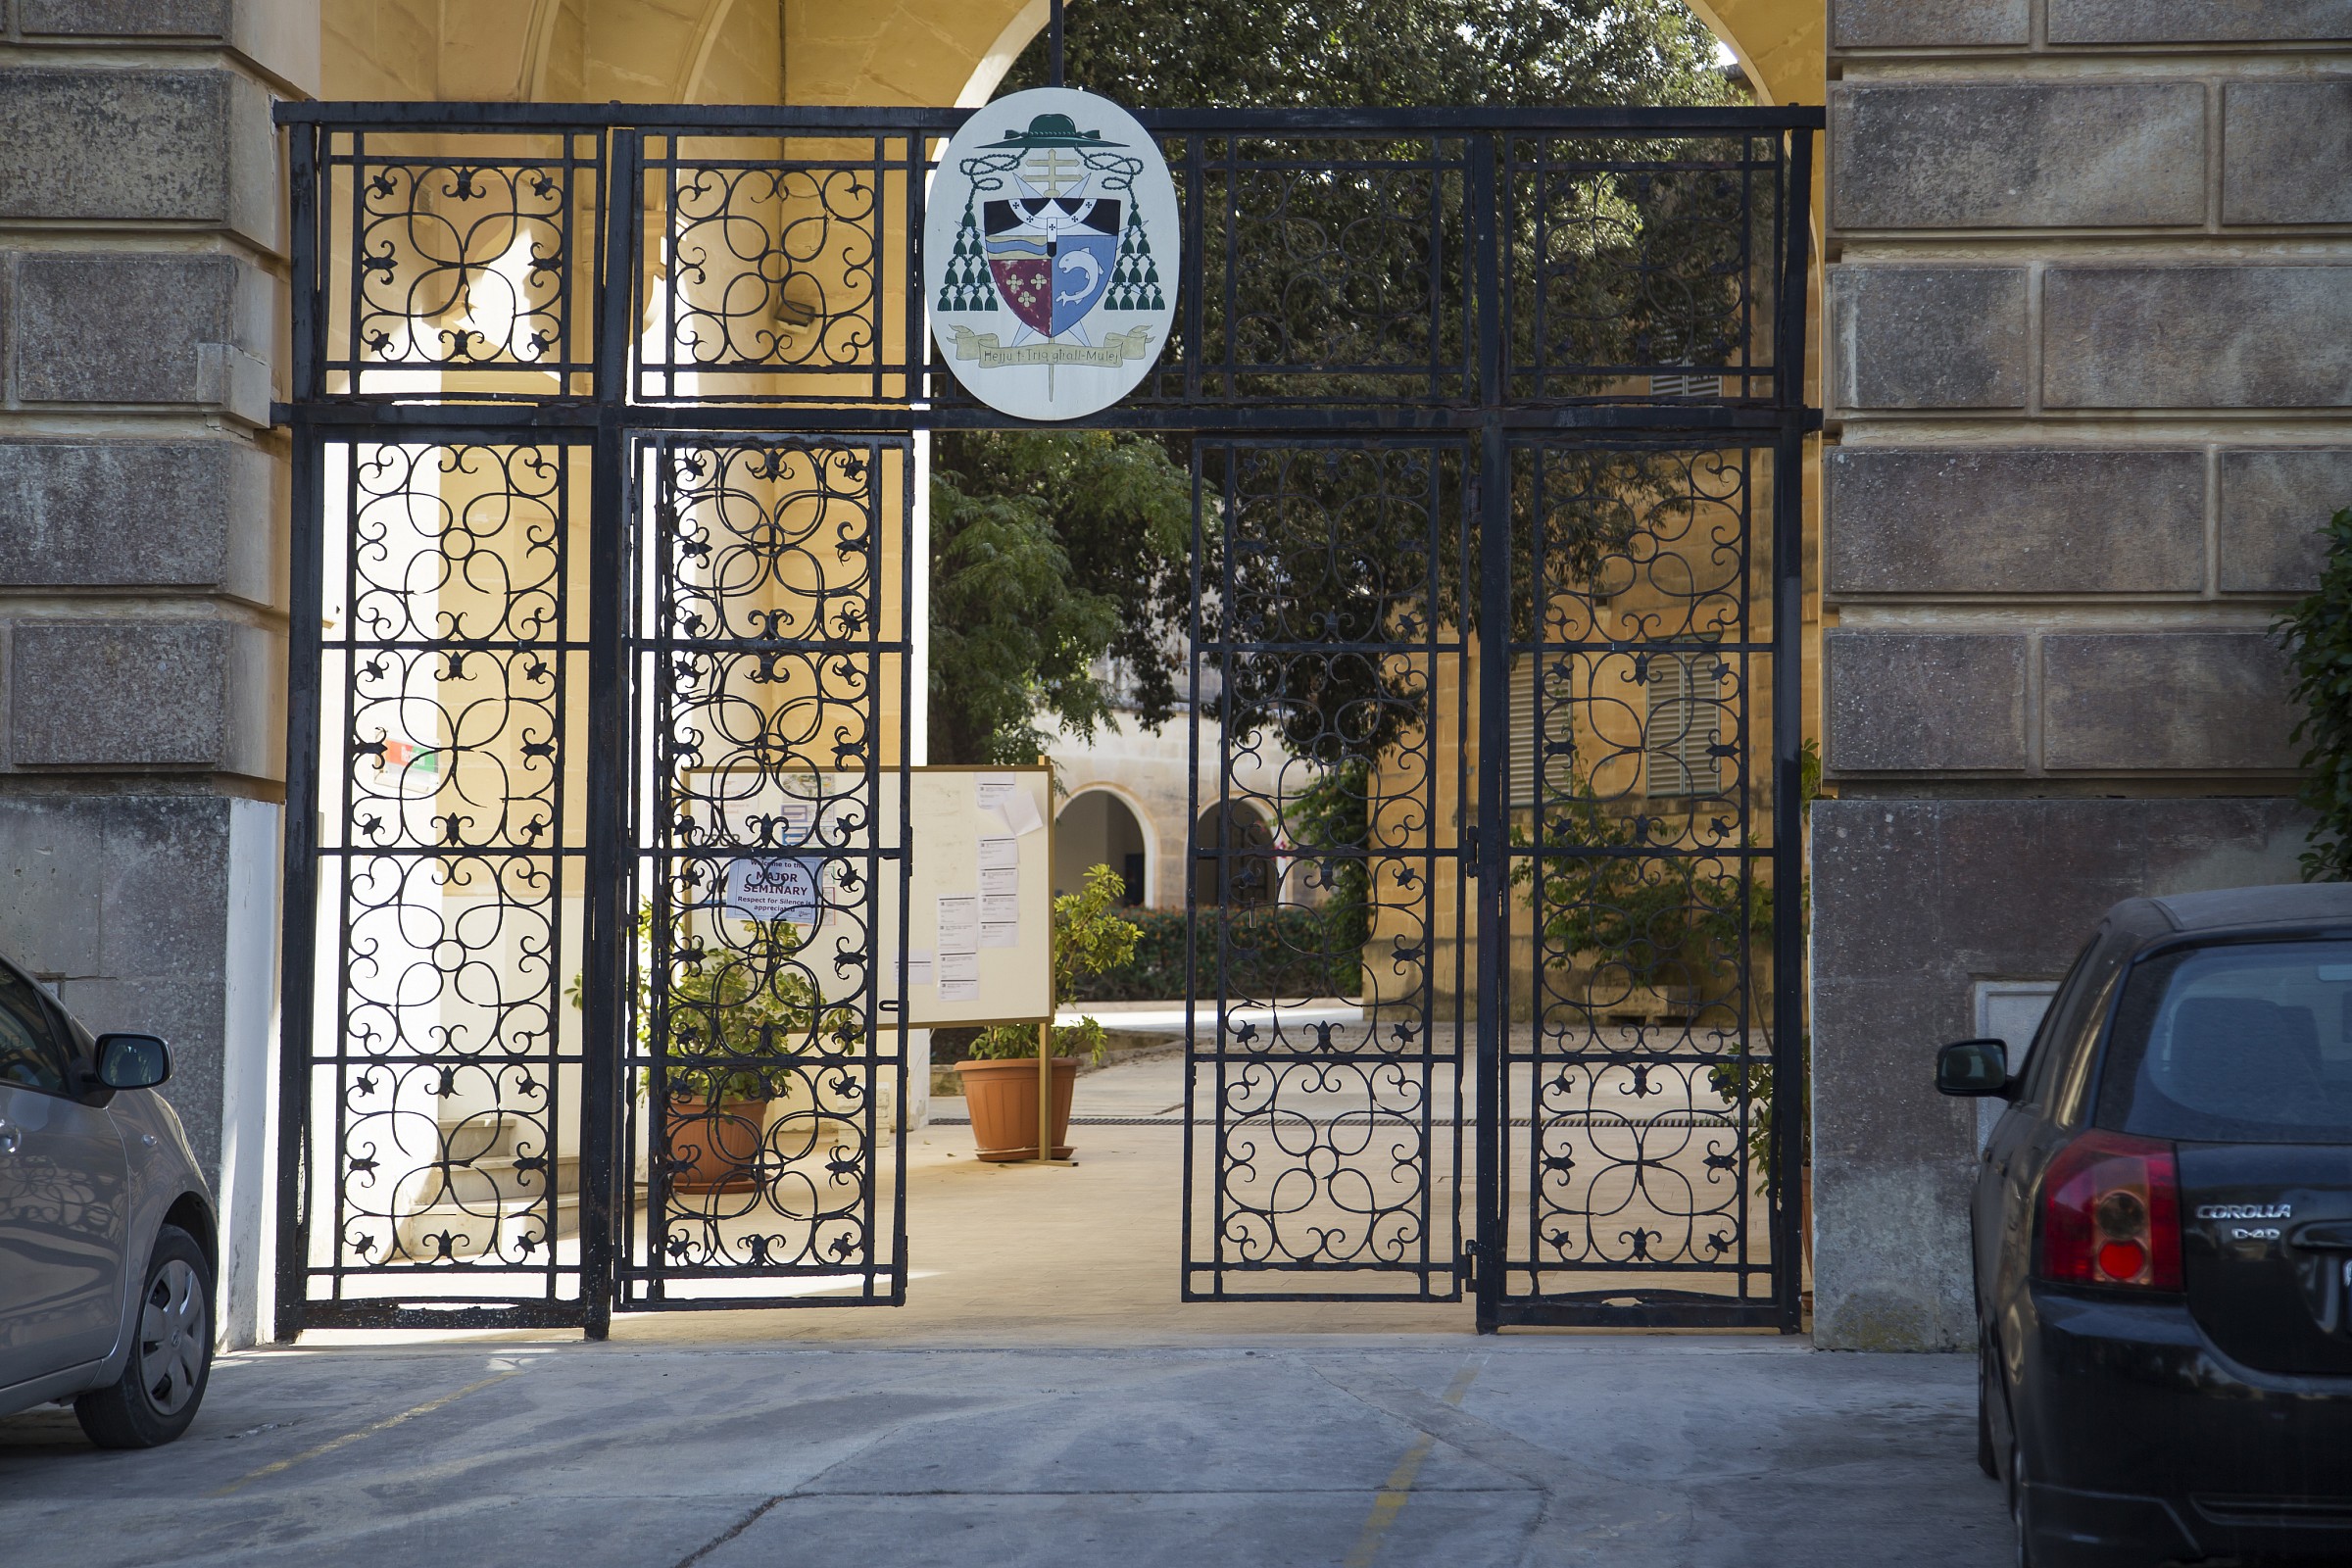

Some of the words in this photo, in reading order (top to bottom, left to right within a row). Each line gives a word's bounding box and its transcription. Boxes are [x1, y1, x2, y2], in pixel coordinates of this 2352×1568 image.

[756, 871, 798, 883] MAJOR
[743, 884, 808, 896] SEMINARY
[2196, 1203, 2292, 1219] COROLLA
[2230, 1228, 2281, 1240] D-4D
